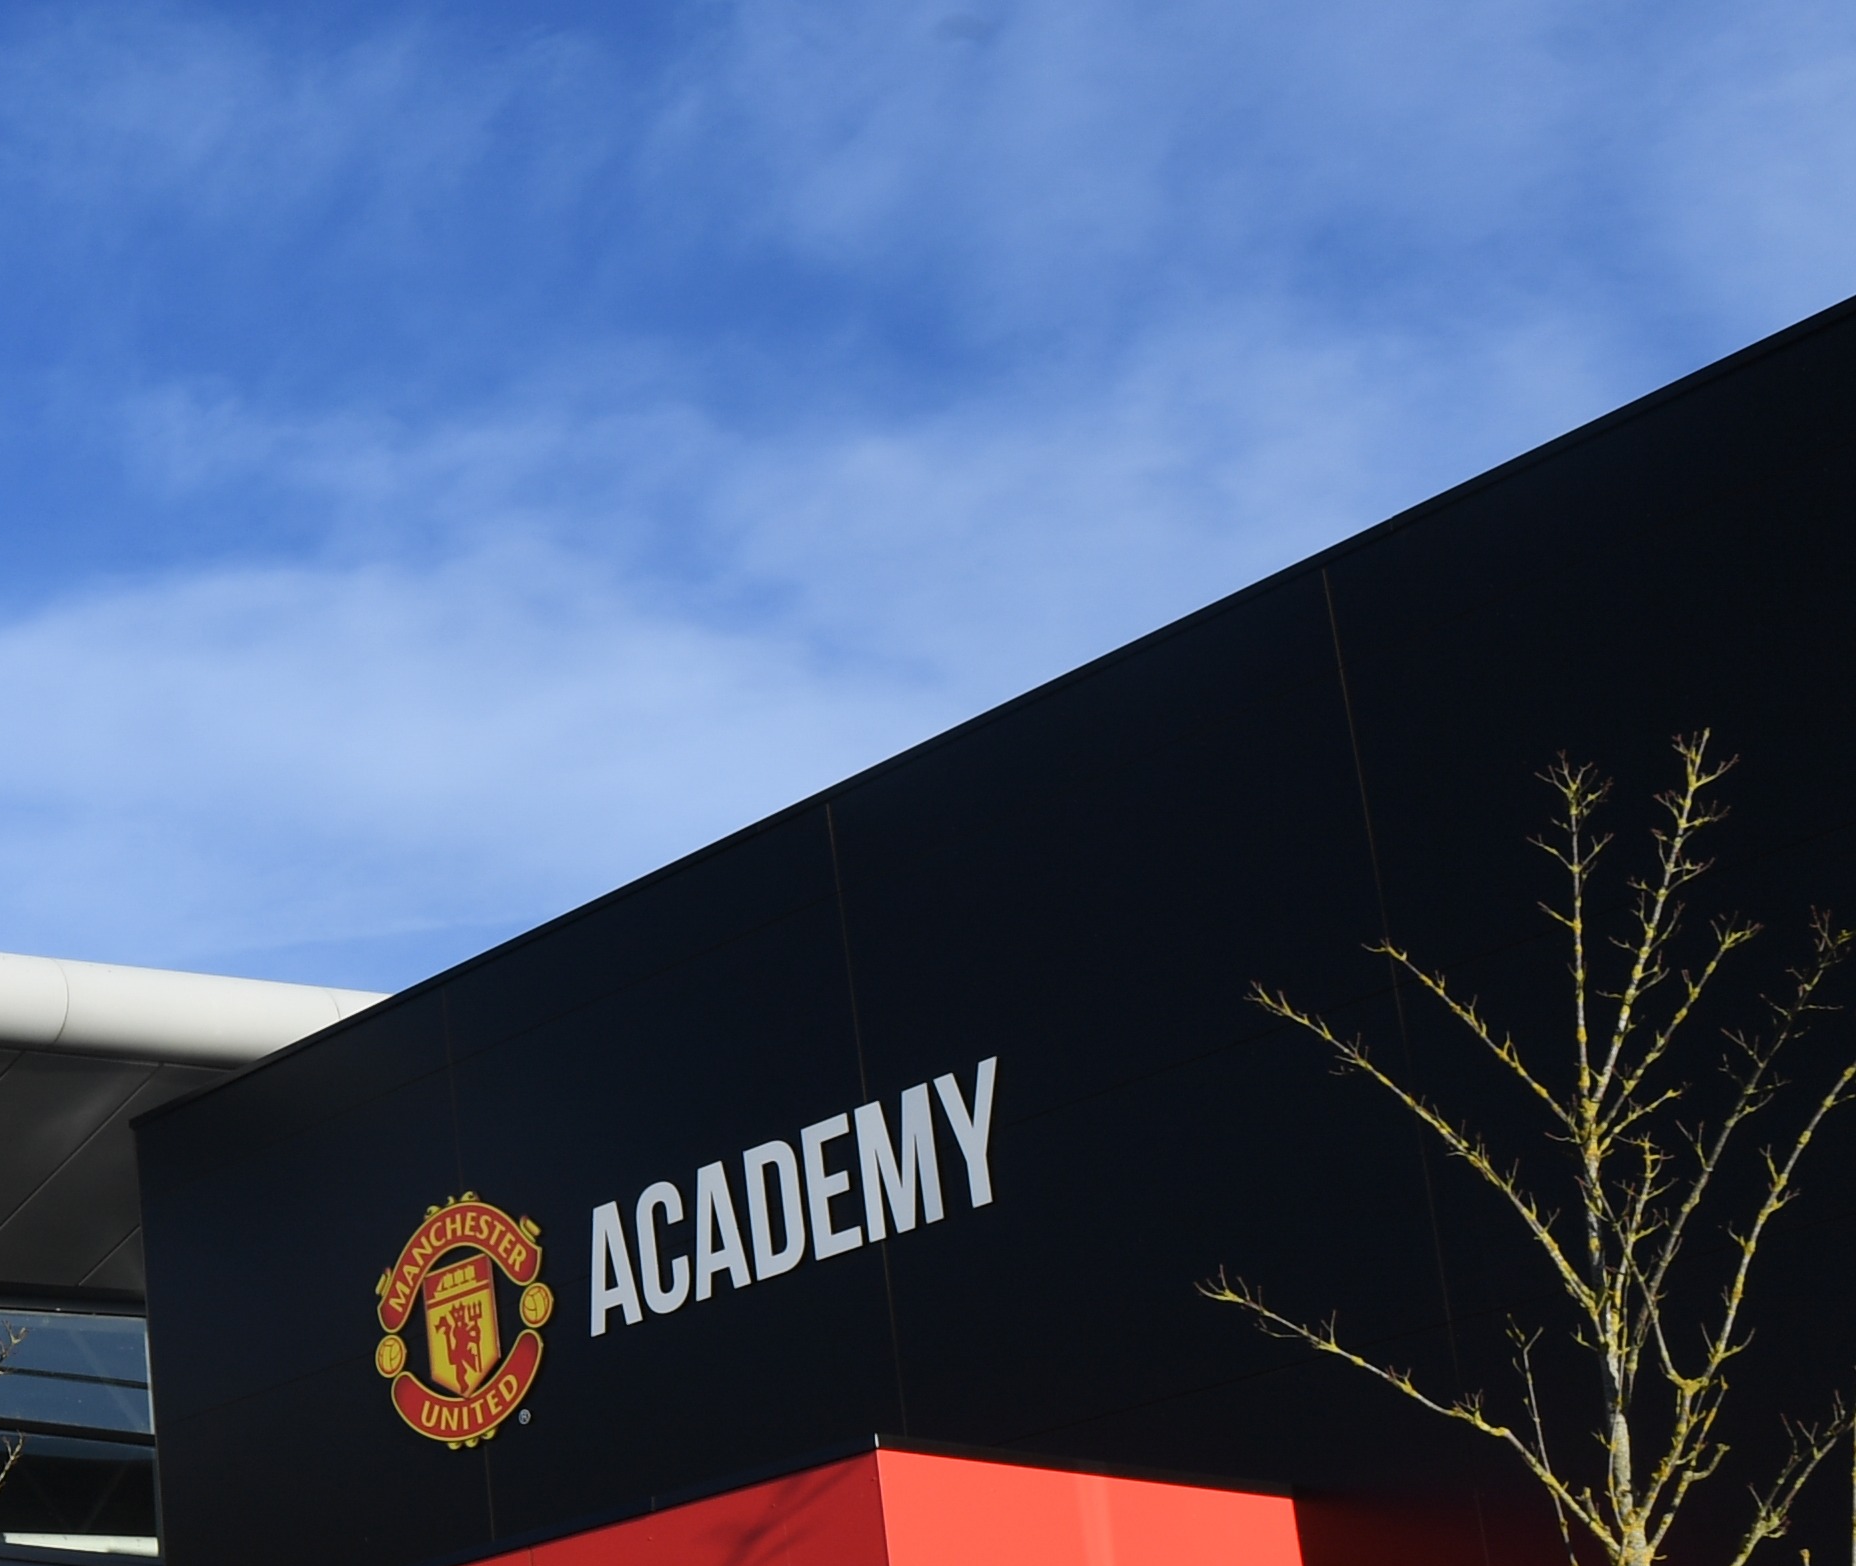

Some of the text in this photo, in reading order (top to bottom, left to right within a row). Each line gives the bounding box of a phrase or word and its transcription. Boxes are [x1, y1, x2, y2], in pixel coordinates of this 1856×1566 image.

[590, 1055, 998, 1338] ACADEMY
[389, 1211, 527, 1313] MANCHESTER
[420, 1373, 519, 1431] UNITED
